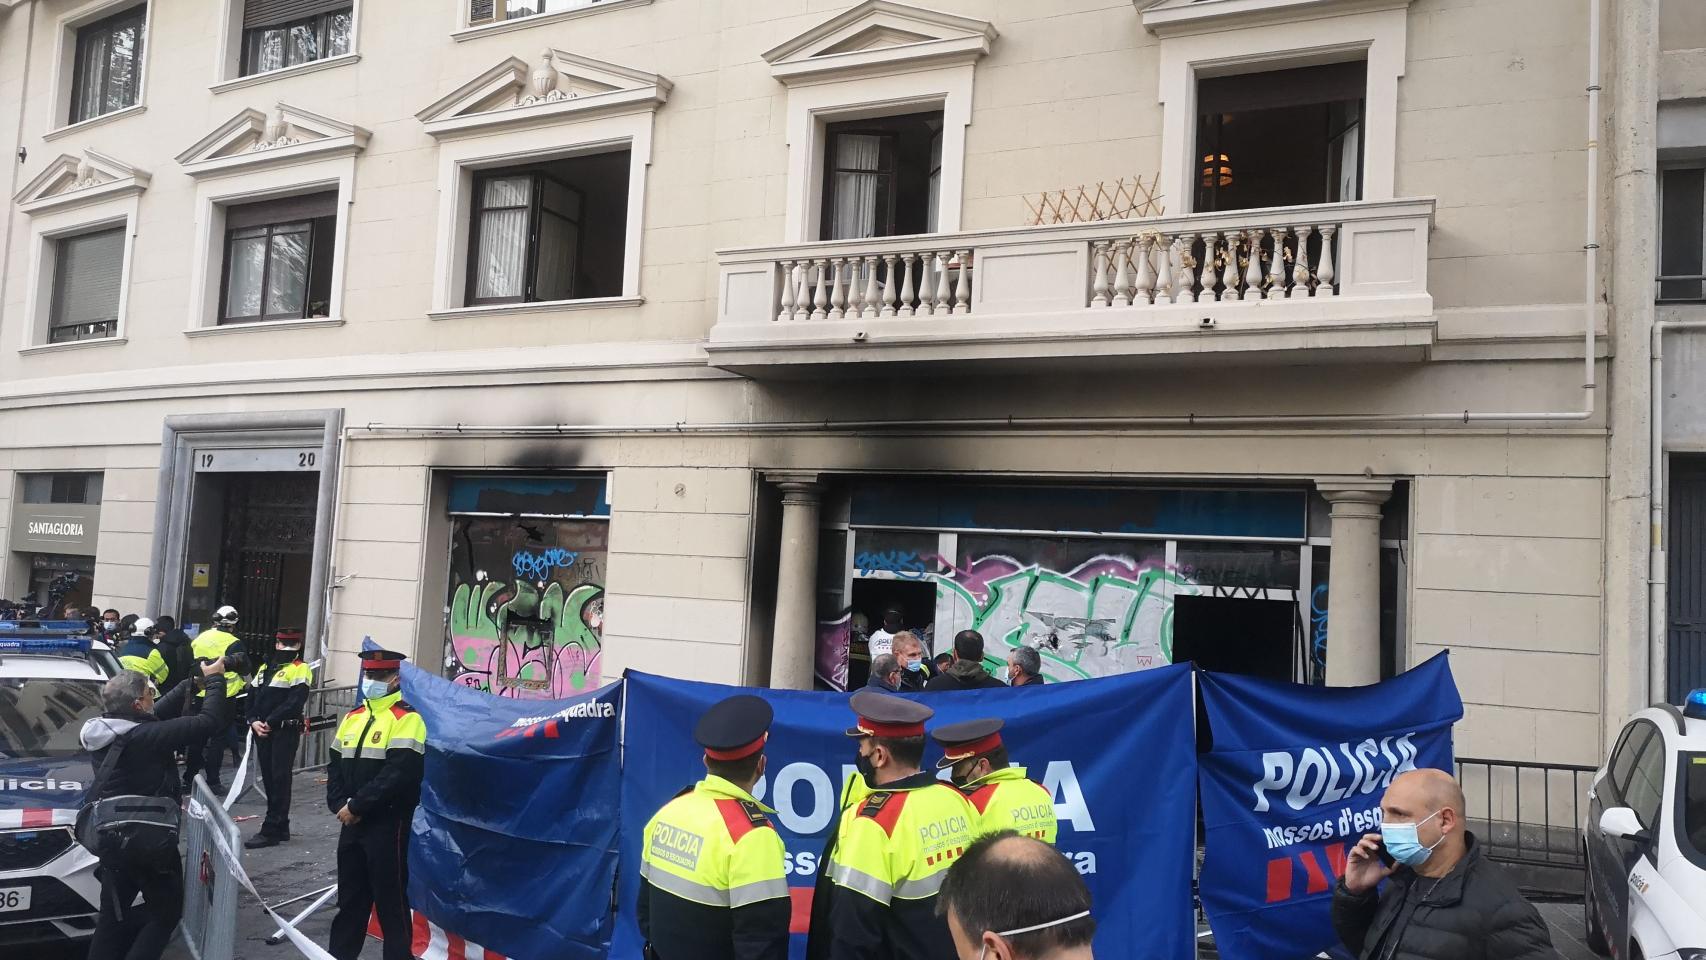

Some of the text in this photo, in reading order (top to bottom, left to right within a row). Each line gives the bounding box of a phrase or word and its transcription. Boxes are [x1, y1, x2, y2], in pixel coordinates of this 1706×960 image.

[202, 454, 213, 468] 19
[298, 452, 315, 467] 20
[28, 522, 83, 536] SANTAGLORIA
[1253, 732, 1418, 812] POLICIA
[1011, 803, 1054, 823] POLICIA
[919, 815, 967, 844] POLICIA
[653, 823, 699, 857] POLICIA
